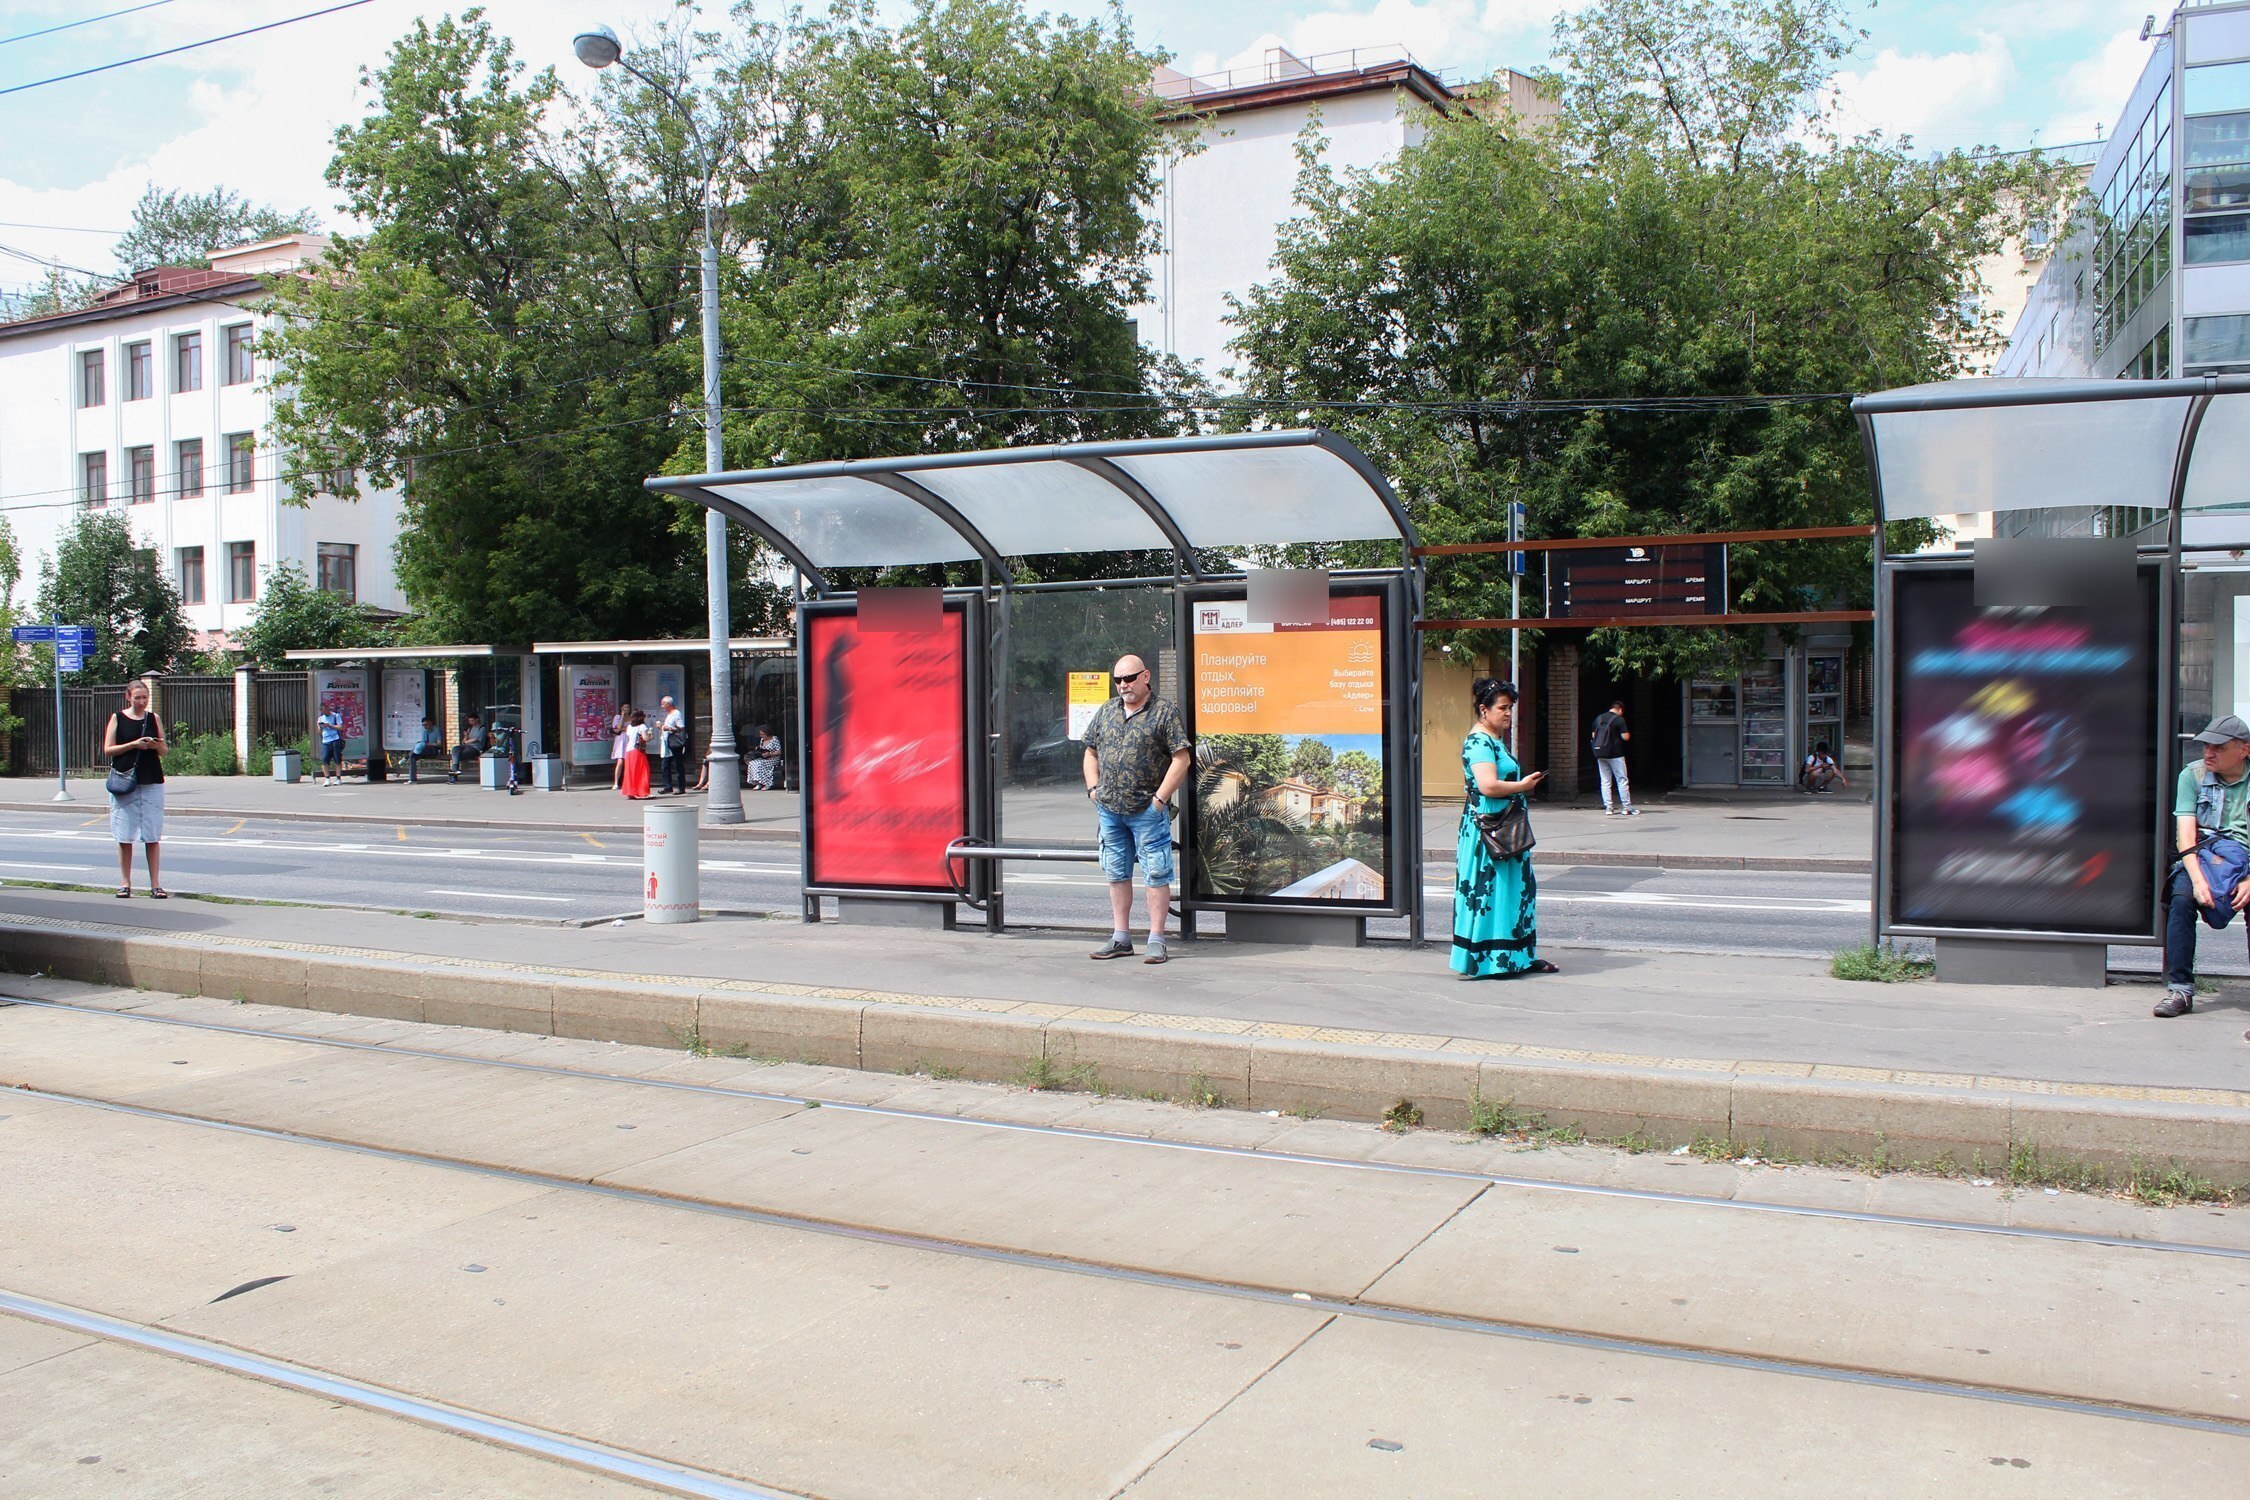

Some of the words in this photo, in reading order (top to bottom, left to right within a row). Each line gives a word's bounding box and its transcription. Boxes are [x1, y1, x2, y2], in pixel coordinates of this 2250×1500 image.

[1221, 621, 1244, 629] АДЛЕР
[1330, 618, 1346, 626] (495)
[1366, 617, 1374, 625] 00
[1201, 652, 1267, 668] Планируйте
[1201, 671, 1236, 683] отдых,
[1333, 669, 1374, 677] Выбирайте
[1329, 680, 1346, 690] базу
[1201, 684, 1265, 700] укрепляйте
[1201, 700, 1257, 715] здоровье!
[1358, 882, 1375, 894] 0+
